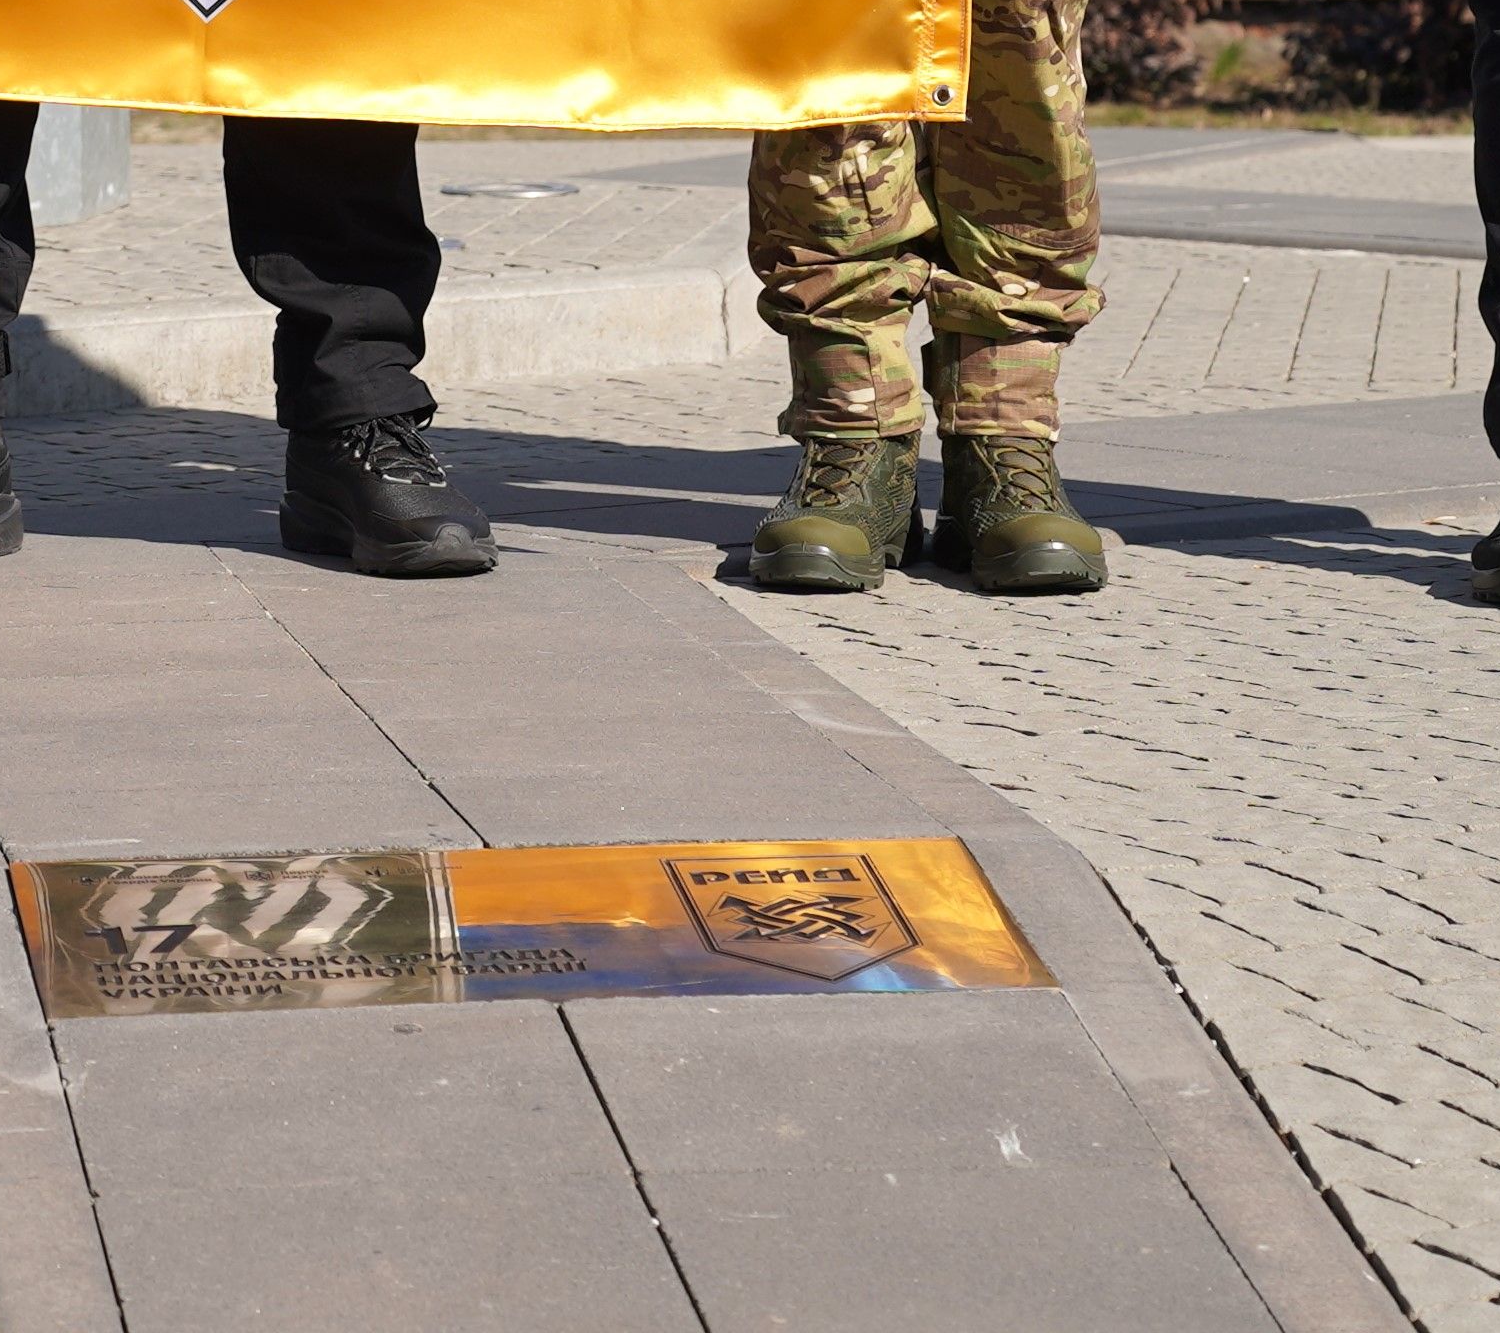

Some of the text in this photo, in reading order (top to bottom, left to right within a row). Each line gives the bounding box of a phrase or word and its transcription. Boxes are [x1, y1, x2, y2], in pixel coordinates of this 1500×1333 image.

[688, 867, 862, 886] РЕЙД
[84, 923, 198, 955] 17
[93, 948, 577, 973] ПОЛТАВСЬКА БРИГАДА
[96, 957, 588, 986] НАЦІОНАЛЬНОЇ ГВАРДІЇ
[100, 982, 283, 999] УКРАЇНИ
